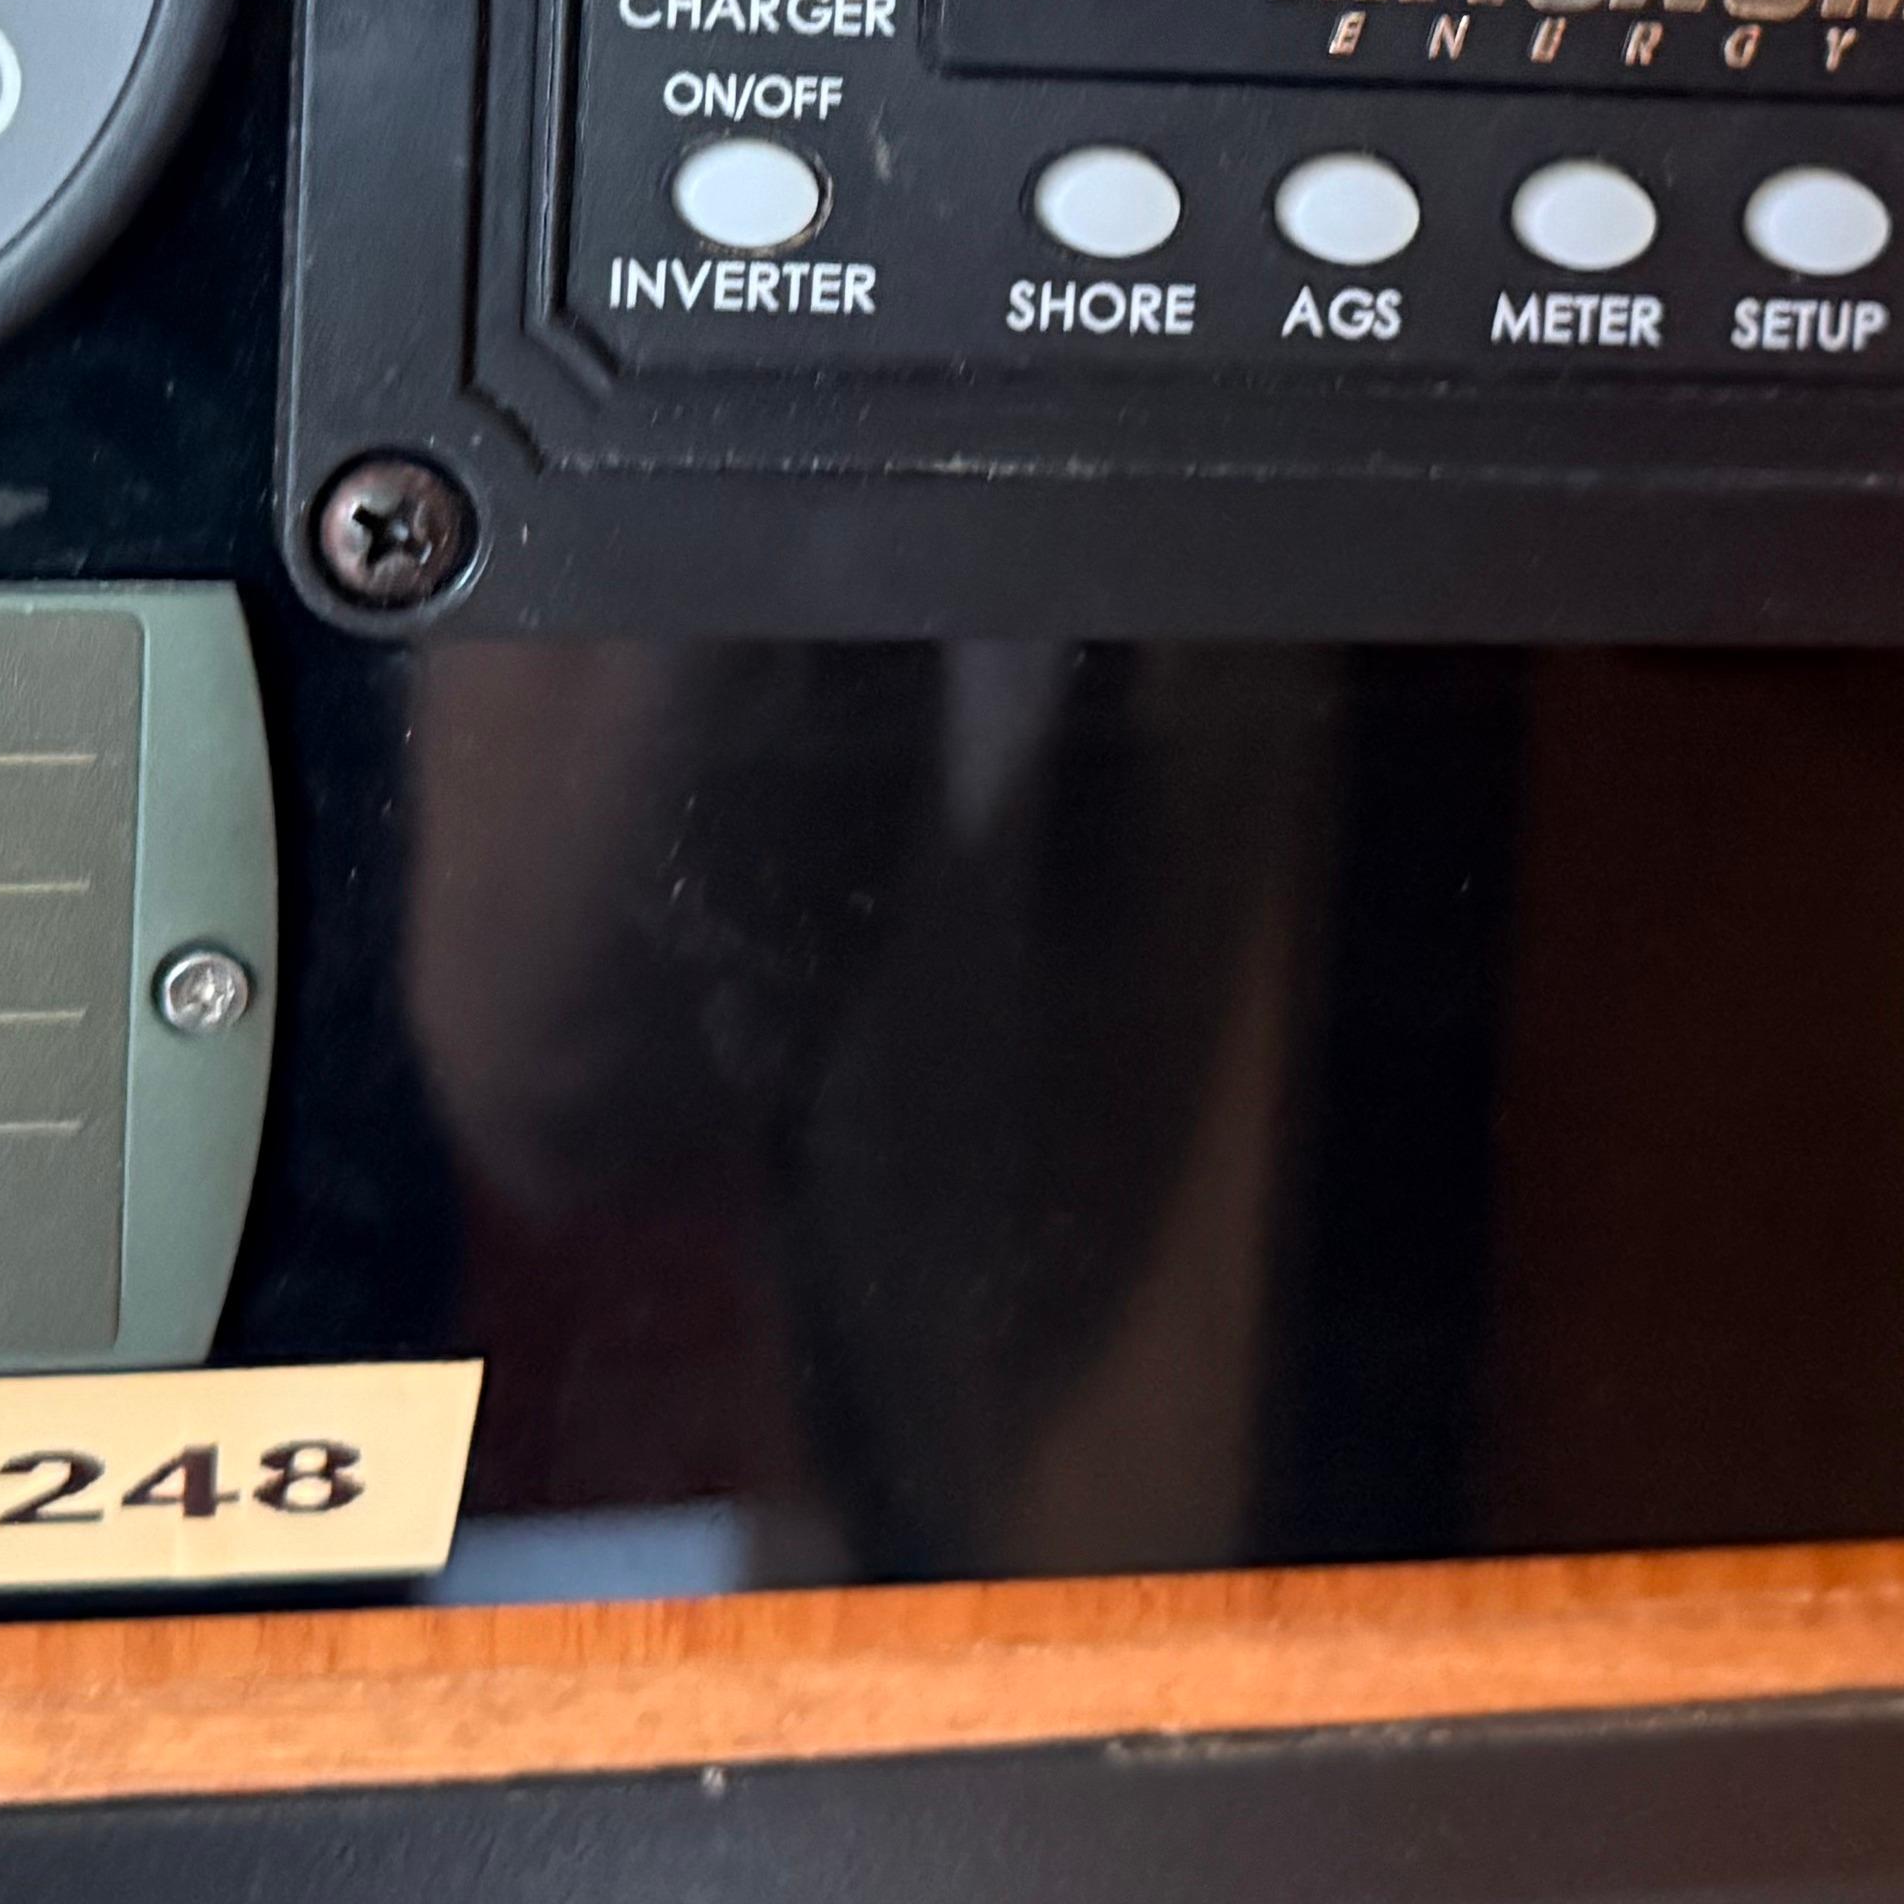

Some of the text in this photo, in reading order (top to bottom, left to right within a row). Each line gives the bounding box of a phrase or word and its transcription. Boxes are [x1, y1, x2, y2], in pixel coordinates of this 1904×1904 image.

[662, 70, 844, 122] ON/OFF
[610, 260, 876, 318] INVERTER
[1006, 280, 1196, 338] SHORE
[1280, 286, 1404, 344] AGS
[1490, 290, 1664, 350] METER
[1730, 296, 1890, 354] SETUP
